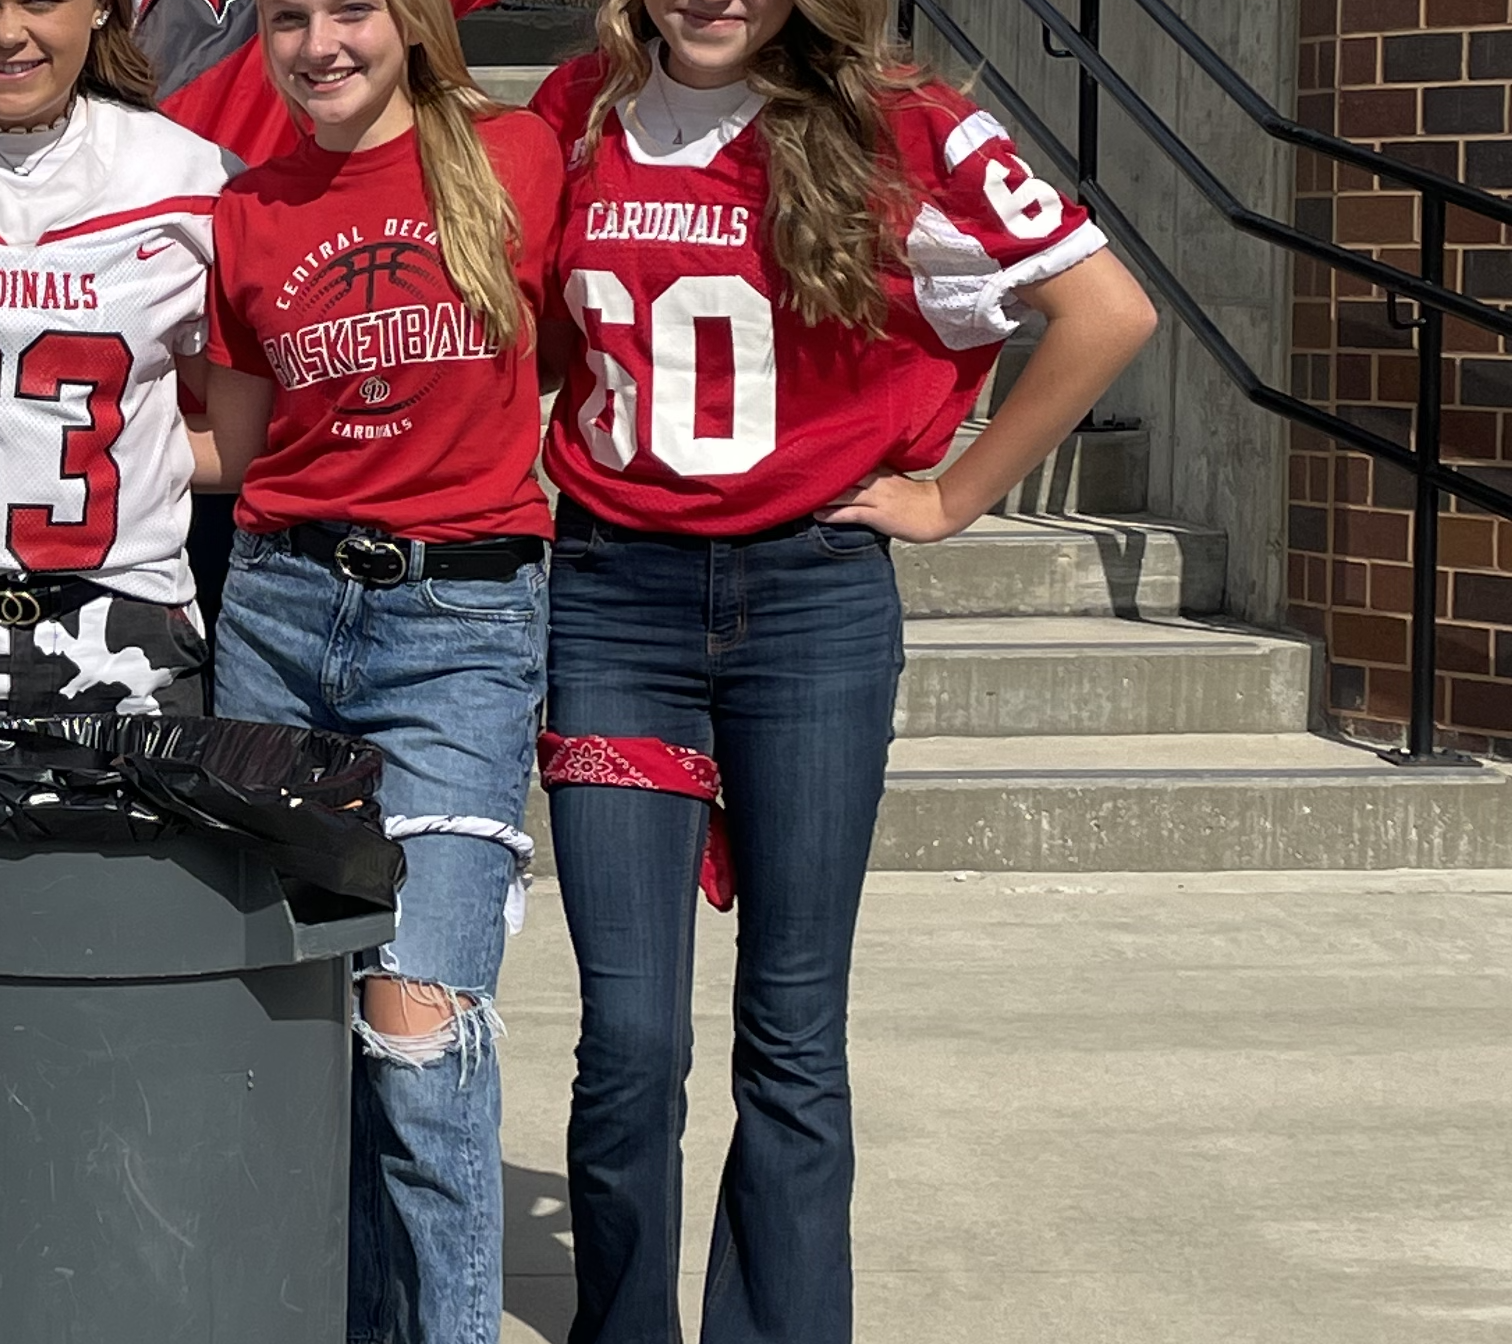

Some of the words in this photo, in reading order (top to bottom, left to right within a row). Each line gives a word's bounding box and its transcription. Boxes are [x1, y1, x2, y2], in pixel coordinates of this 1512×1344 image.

[276, 226, 365, 311] CENTRAL
[383, 218, 439, 246] DECA
[586, 201, 749, 247] CARDINALS
[263, 302, 501, 391] BASKETBALL
[563, 268, 777, 476] 60
